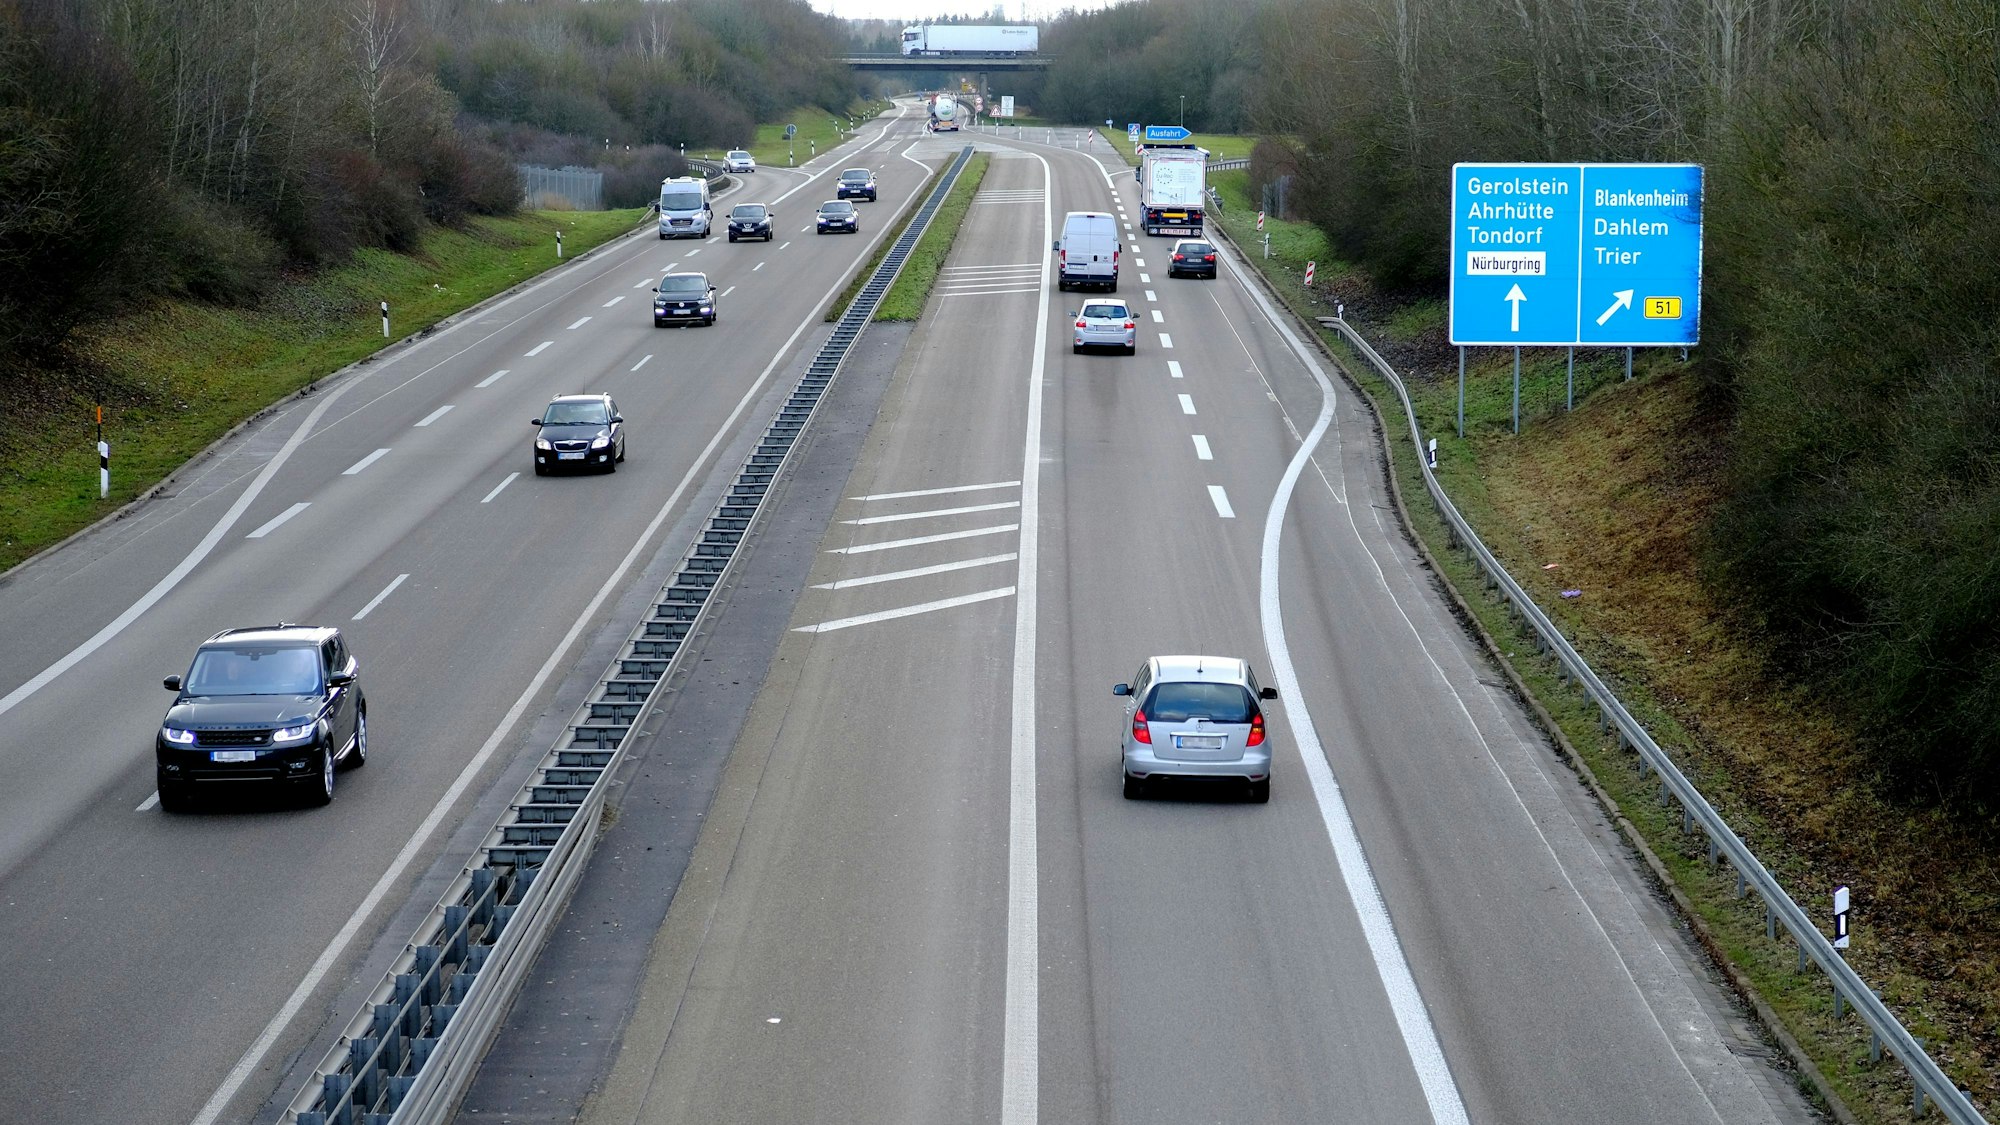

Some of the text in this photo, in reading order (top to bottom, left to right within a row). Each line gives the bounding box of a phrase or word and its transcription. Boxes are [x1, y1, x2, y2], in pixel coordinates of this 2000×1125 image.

[1468, 177, 1569, 195] Gerolstein
[1595, 188, 1689, 207] Blankenheim
[1468, 201, 1554, 220] Ahrhütte
[1467, 226, 1543, 244] Tondorf
[1594, 218, 1669, 236] Dahlem
[1472, 256, 1541, 273] Nürburgring
[1594, 247, 1642, 265] Trier
[1655, 301, 1671, 315] 51
